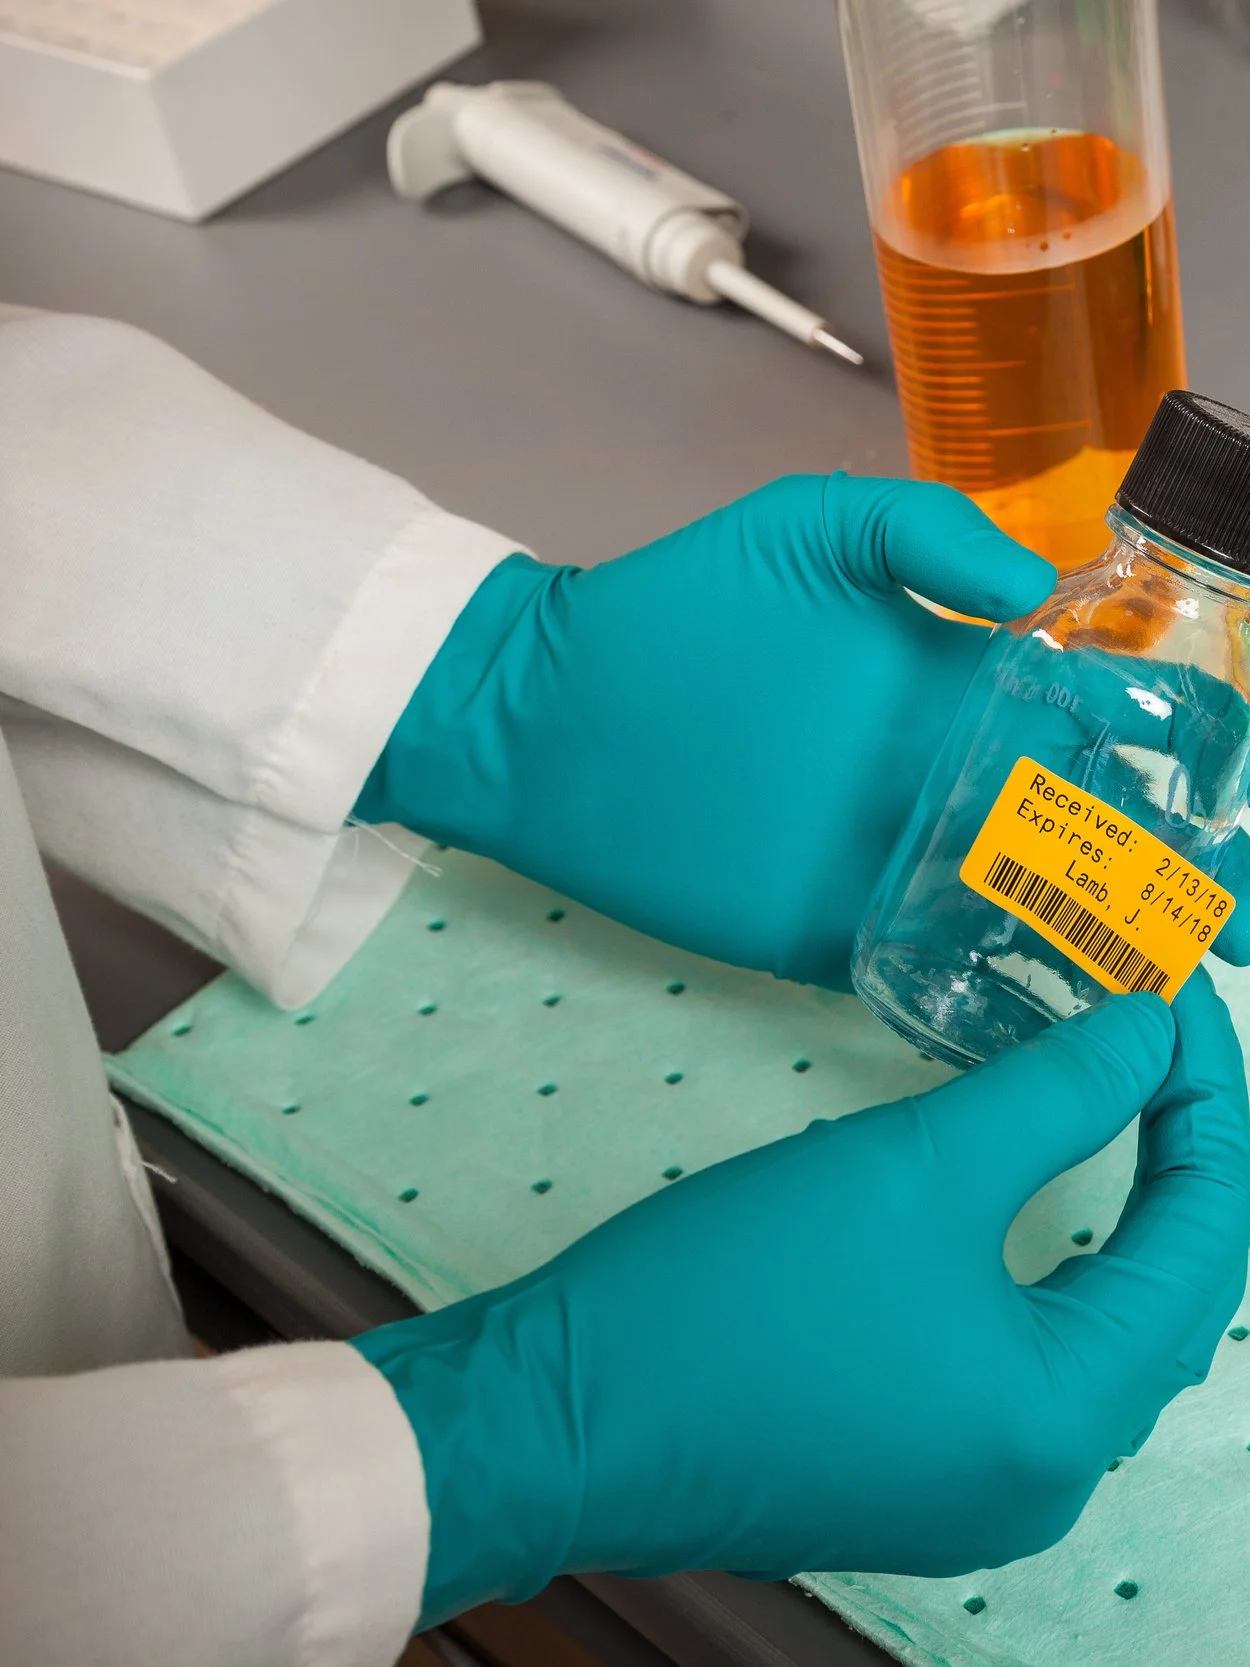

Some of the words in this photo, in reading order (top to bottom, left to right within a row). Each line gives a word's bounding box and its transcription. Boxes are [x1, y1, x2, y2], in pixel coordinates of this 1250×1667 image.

[1016, 798, 1113, 869] Expires:
[1140, 883, 1212, 942] 8/14/18
[1029, 773, 1138, 853] Received:
[1155, 858, 1228, 918] 2/13/18
[1065, 859, 1112, 911] Lamb,
[1124, 908, 1140, 931] J.
